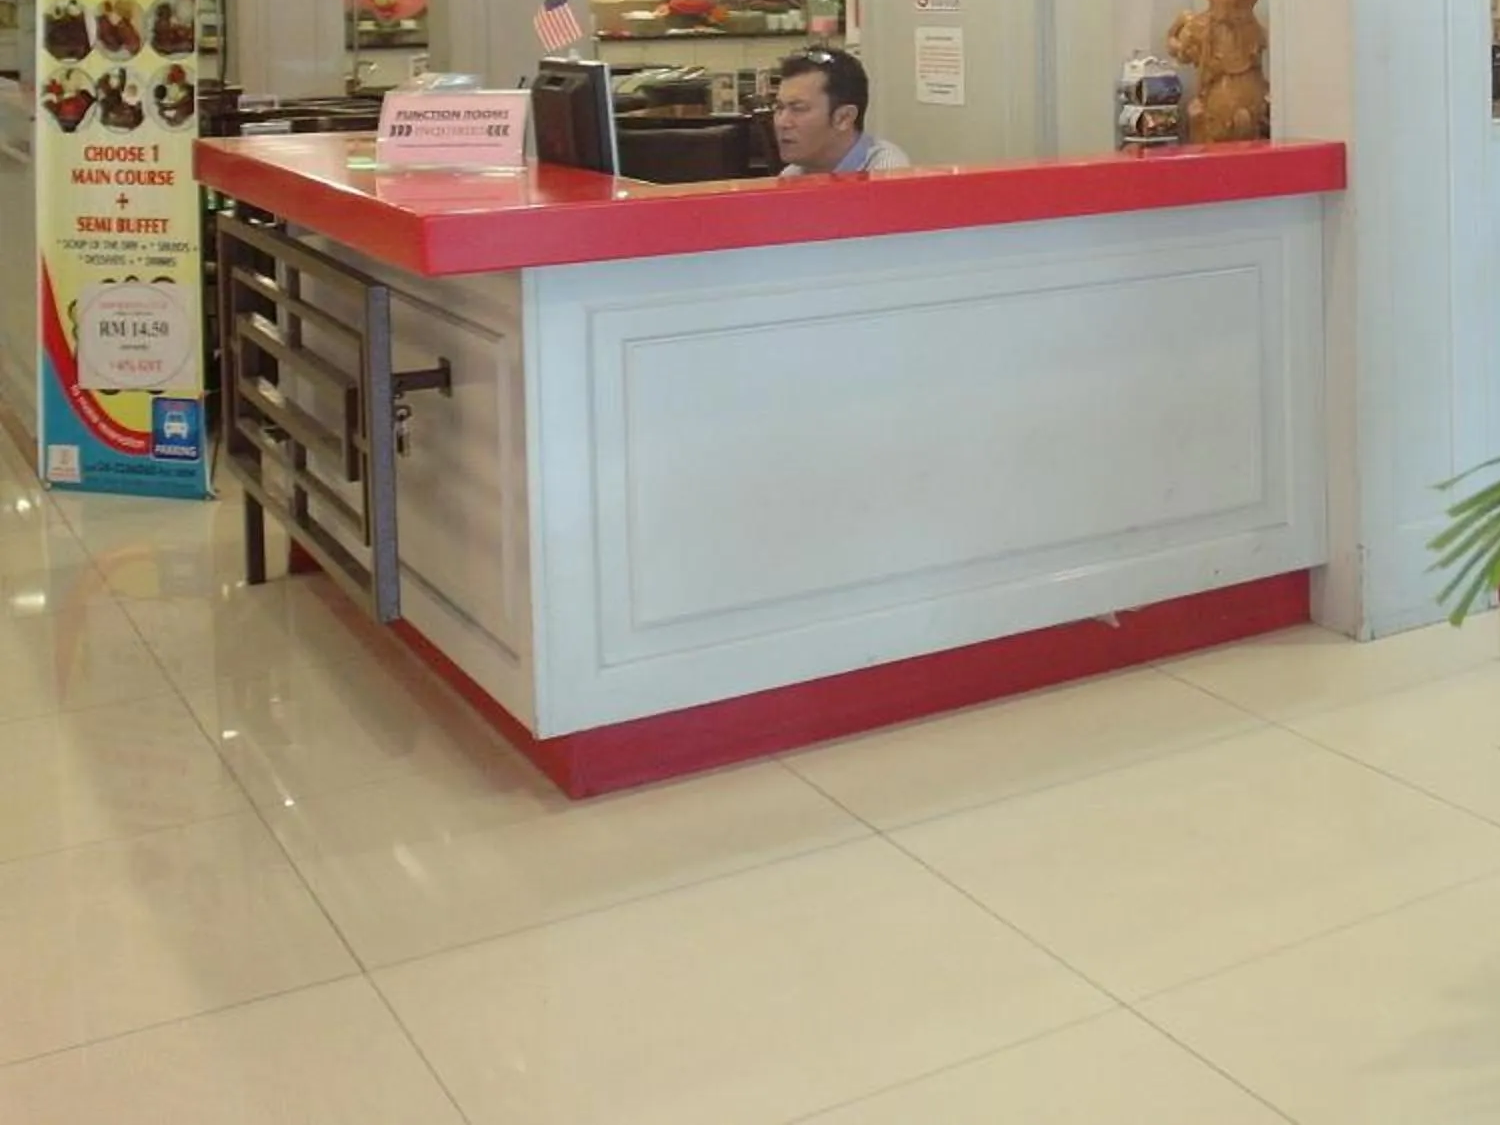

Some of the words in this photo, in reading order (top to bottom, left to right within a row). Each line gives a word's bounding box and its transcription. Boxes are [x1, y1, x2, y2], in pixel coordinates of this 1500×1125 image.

[396, 110, 460, 121] FUNCTION
[84, 145, 145, 163] CHOOSE
[150, 145, 160, 163] 1
[71, 170, 112, 185] MAIN
[116, 170, 174, 185] COURSE
[76, 217, 111, 232] SEMI
[116, 218, 168, 233] BUFFET
[99, 321, 125, 337] RM
[132, 320, 169, 337] 14.50
